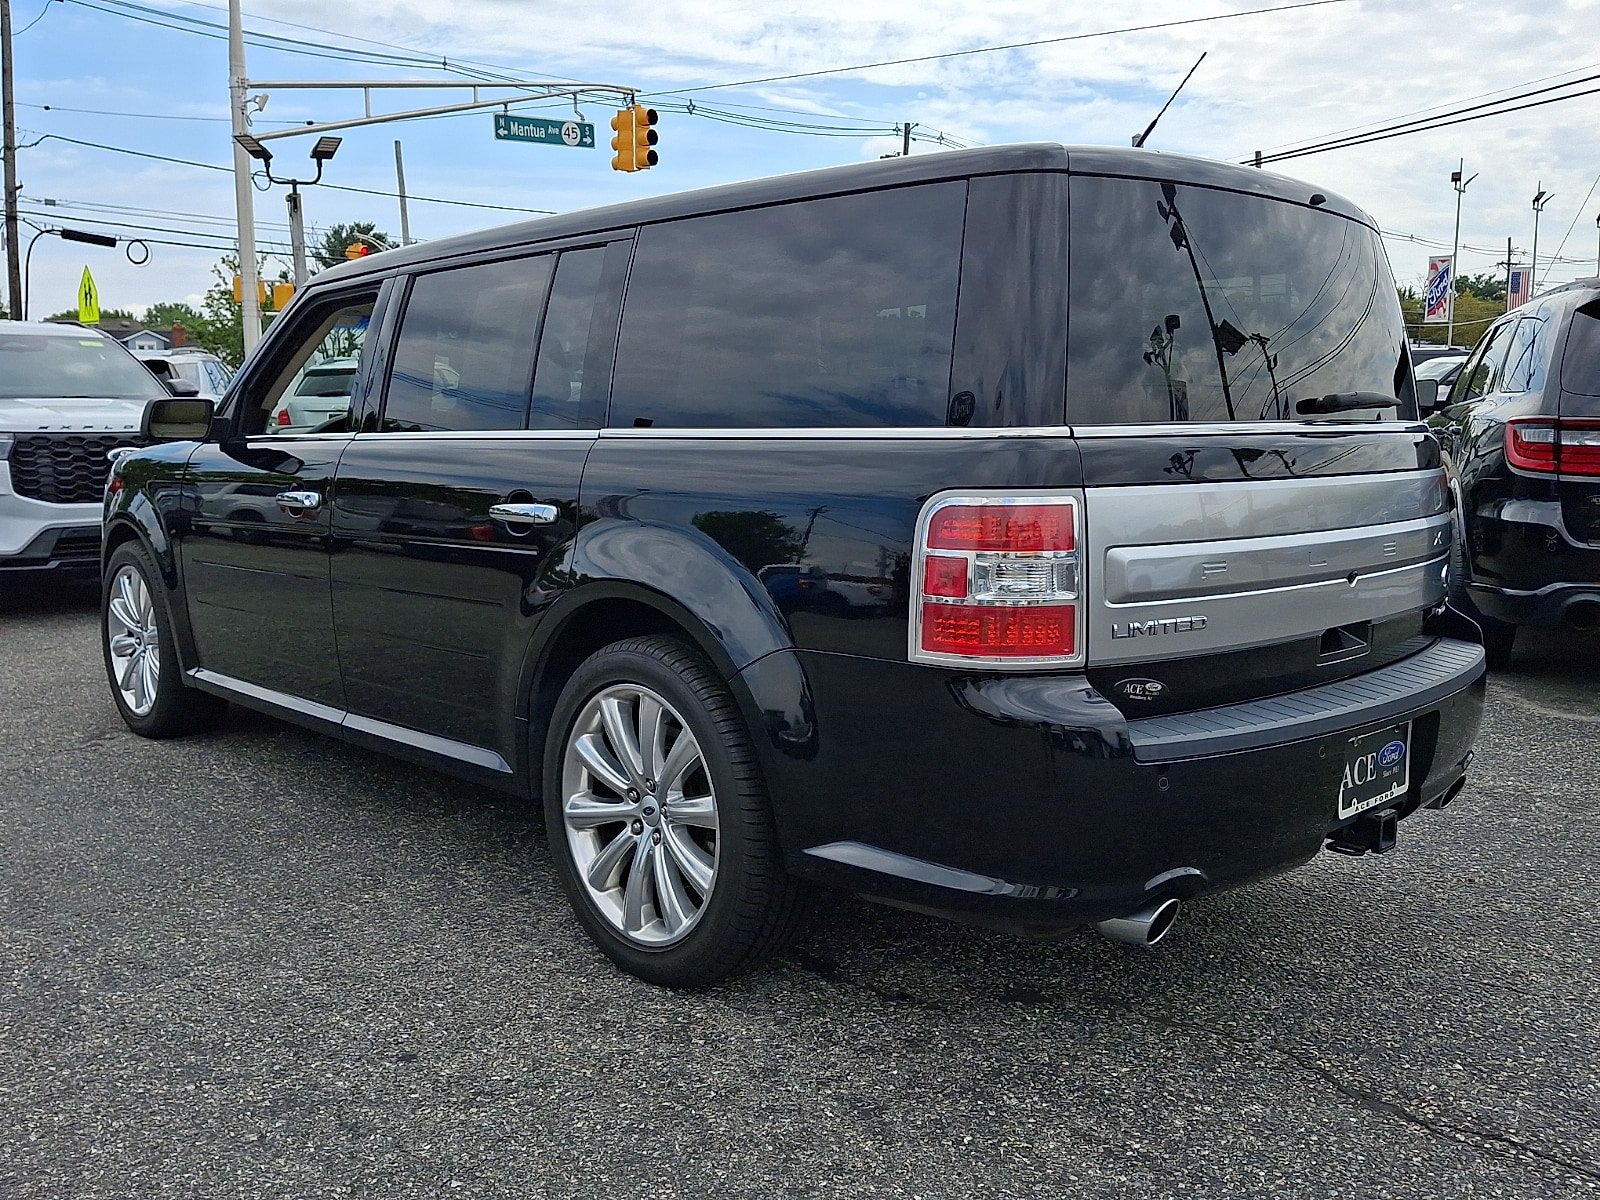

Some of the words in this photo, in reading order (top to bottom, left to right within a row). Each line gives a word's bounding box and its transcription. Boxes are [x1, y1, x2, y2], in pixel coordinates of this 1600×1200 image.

[510, 121, 546, 138] Mantua
[548, 124, 559, 135] Ave
[563, 127, 578, 140] 45
[585, 127, 590, 135] S
[1428, 271, 1448, 305] Ford
[1201, 530, 1443, 580] FLEX
[1111, 615, 1208, 640] LIMITED
[1122, 683, 1144, 695] ACE
[1340, 752, 1377, 791] ACE
[1354, 802, 1370, 812] ACE
[1374, 792, 1394, 804] FORD
